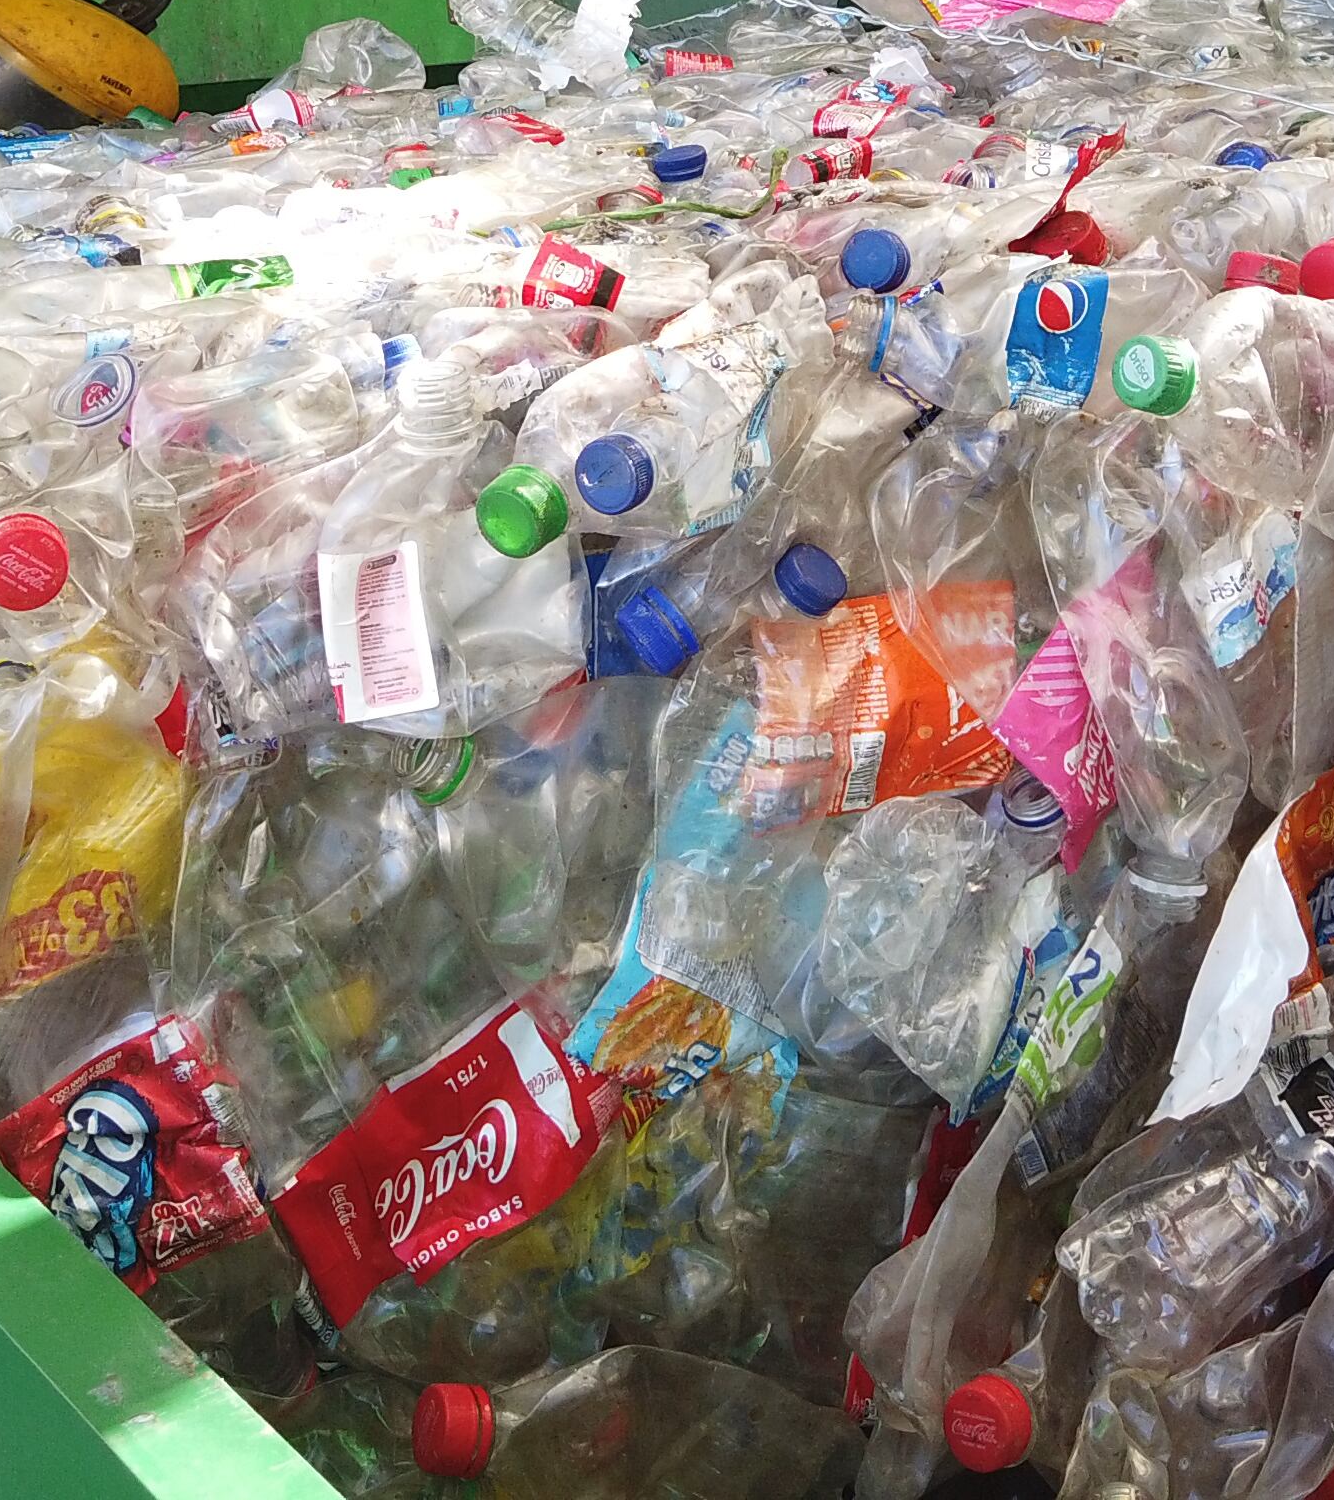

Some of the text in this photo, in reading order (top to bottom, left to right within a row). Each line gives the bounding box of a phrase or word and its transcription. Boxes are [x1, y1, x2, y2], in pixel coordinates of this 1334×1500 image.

[1128, 347, 1150, 383] brisa
[455, 1054, 488, 1086] 1.75
[464, 1193, 524, 1236] SABOR
[952, 1417, 998, 1444] Coca-Cola
